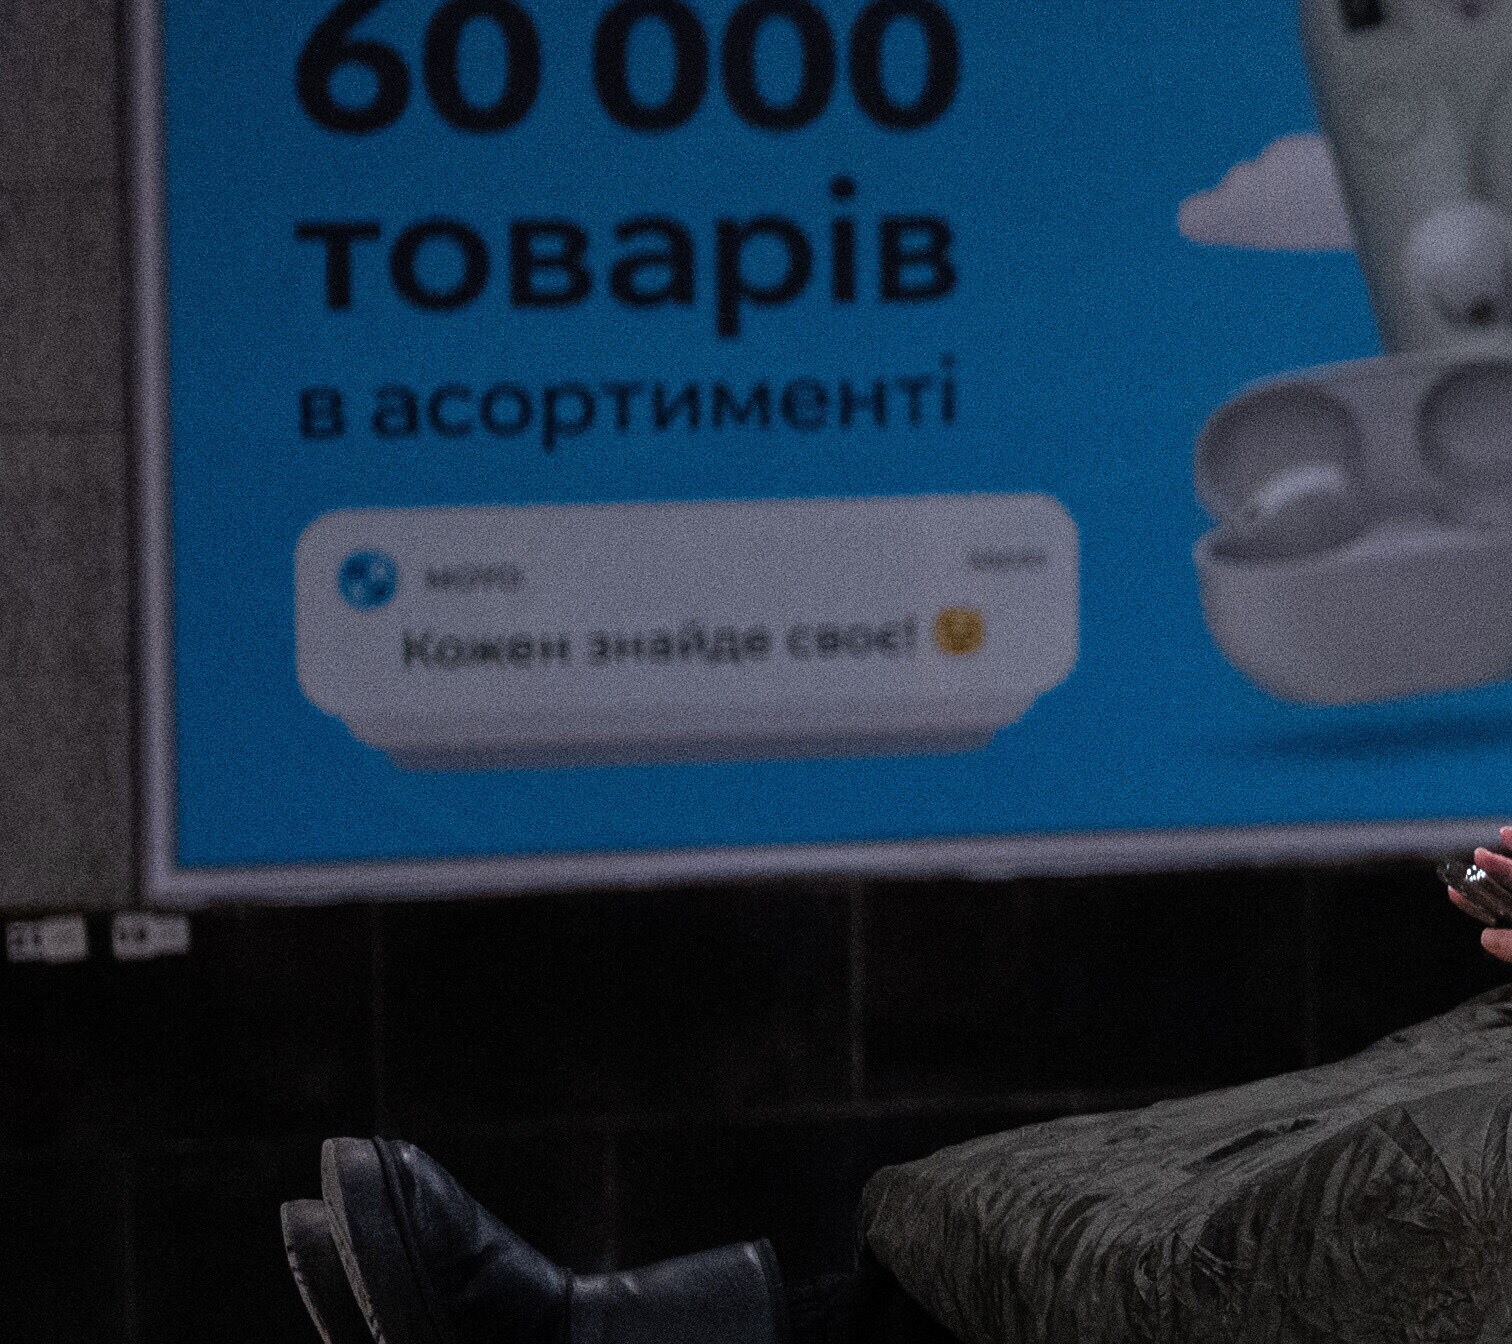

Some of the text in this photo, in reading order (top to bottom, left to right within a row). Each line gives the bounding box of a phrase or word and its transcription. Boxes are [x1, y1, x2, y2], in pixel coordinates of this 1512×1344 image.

[295, 176, 958, 338] товарів
[300, 353, 957, 453] в асортименті
